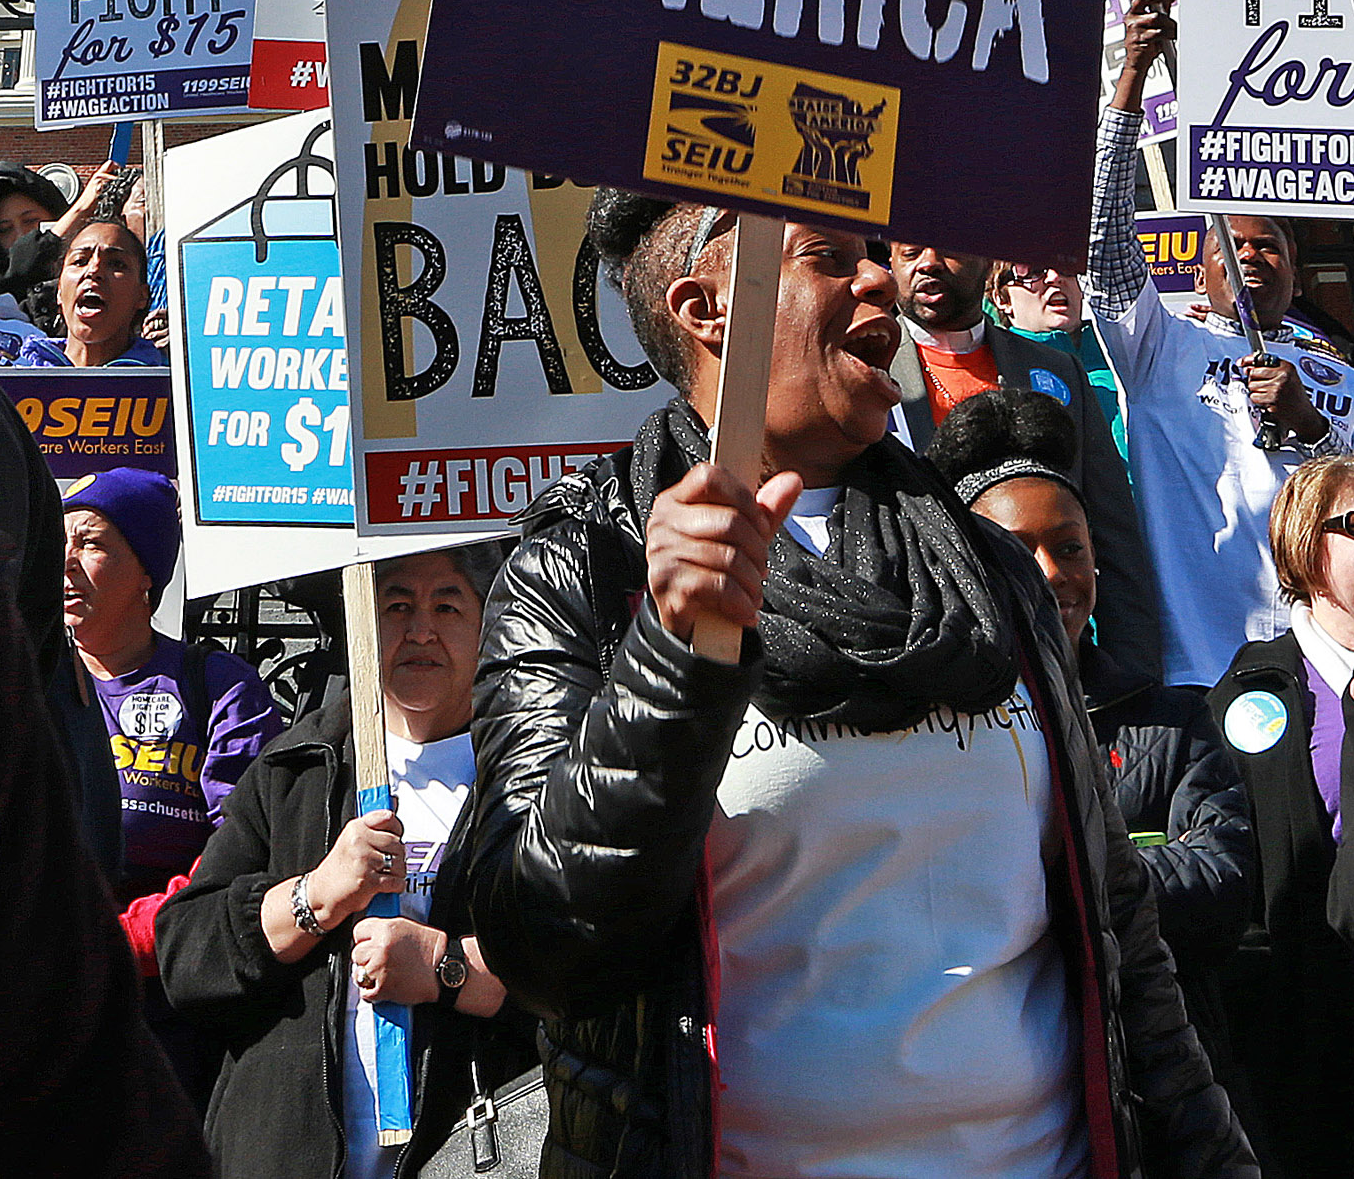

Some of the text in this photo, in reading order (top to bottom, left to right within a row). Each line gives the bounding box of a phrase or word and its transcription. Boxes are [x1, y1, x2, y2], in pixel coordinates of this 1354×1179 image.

[55, 9, 246, 80] for $15
[46, 75, 156, 99] #FIGHTFOR15
[669, 59, 763, 99] 32BJ
[46, 93, 169, 119] #WAGEACTION
[660, 138, 754, 173] SEIU
[203, 276, 344, 338] RETA
[372, 215, 659, 401] BAC
[210, 345, 349, 392] WORKE
[208, 410, 271, 447] FOR
[280, 398, 351, 472] $1
[67, 439, 129, 456] Workers
[135, 439, 166, 455] East
[213, 486, 308, 505] #FIGHTFOR15
[135, 711, 166, 735] $15
[123, 771, 180, 793] Workers
